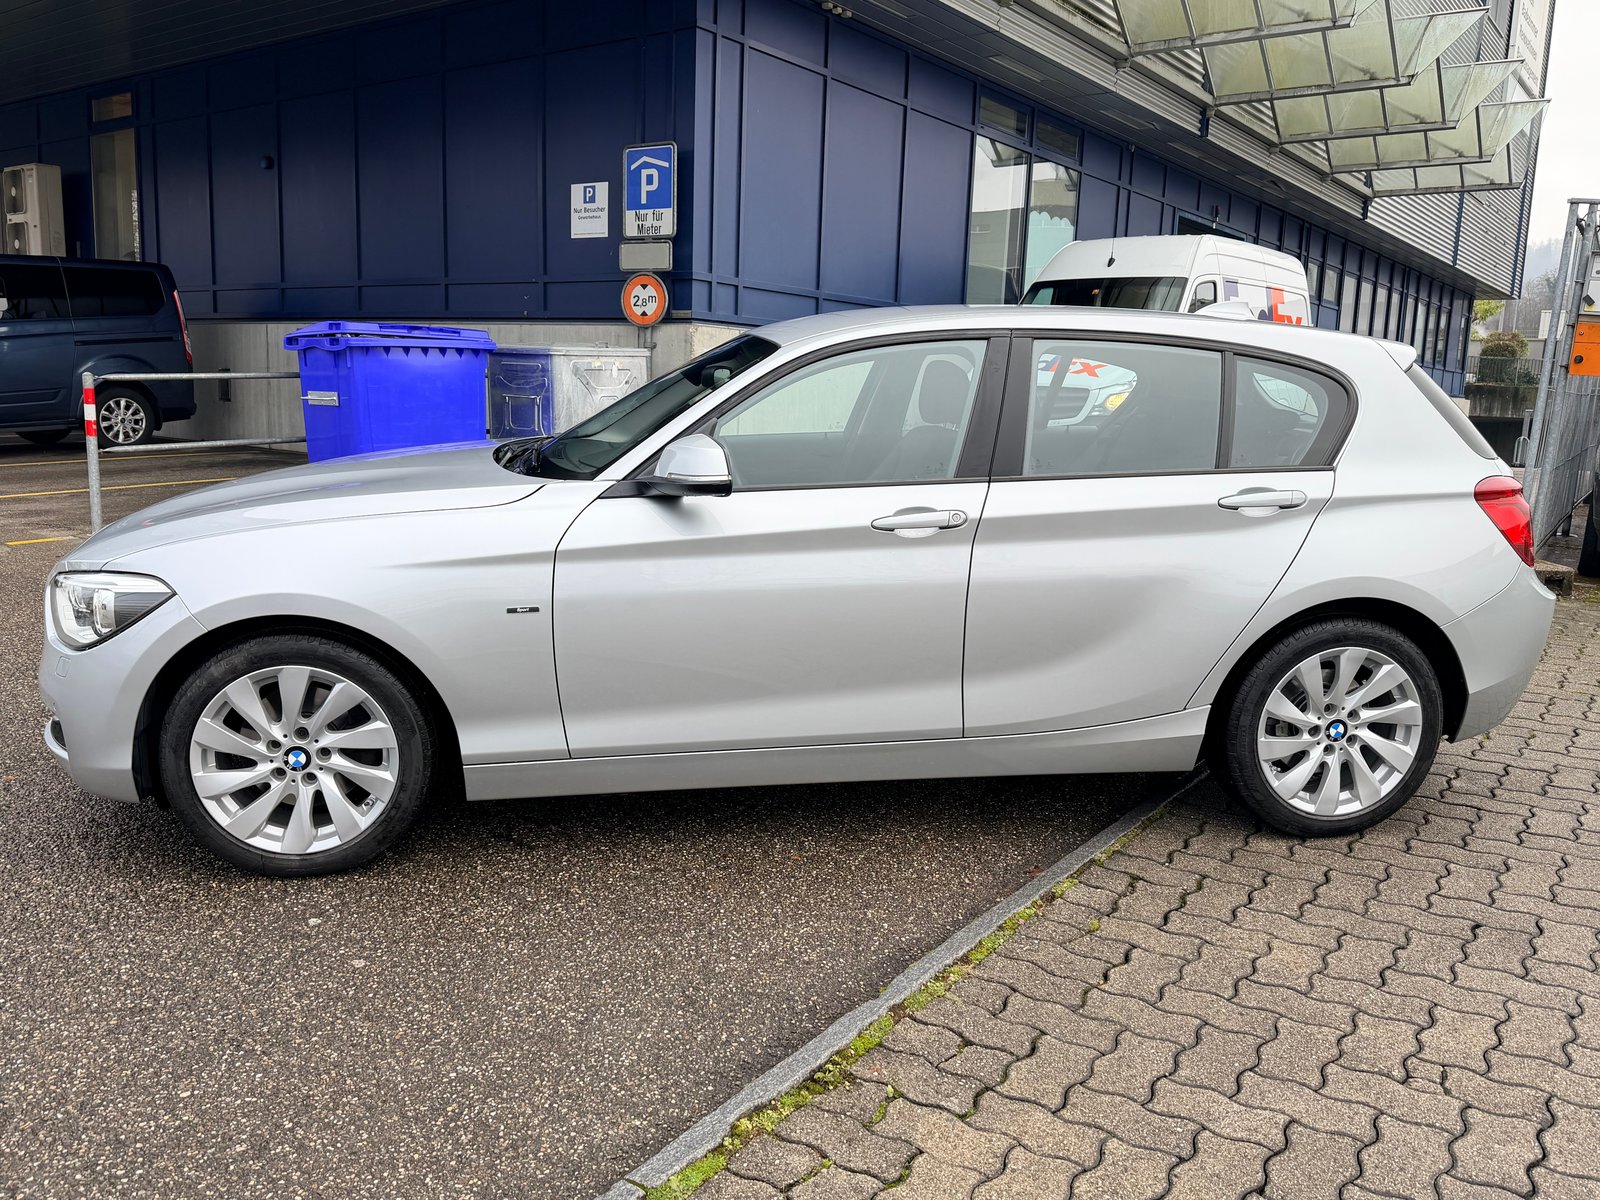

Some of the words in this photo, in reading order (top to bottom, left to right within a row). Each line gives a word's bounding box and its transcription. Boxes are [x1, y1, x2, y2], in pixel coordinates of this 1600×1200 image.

[641, 168, 659, 204] P
[586, 187, 593, 202] P
[584, 206, 606, 214] Besucher
[635, 210, 648, 222] Nur
[652, 209, 664, 221] für
[637, 223, 662, 235] Mieter
